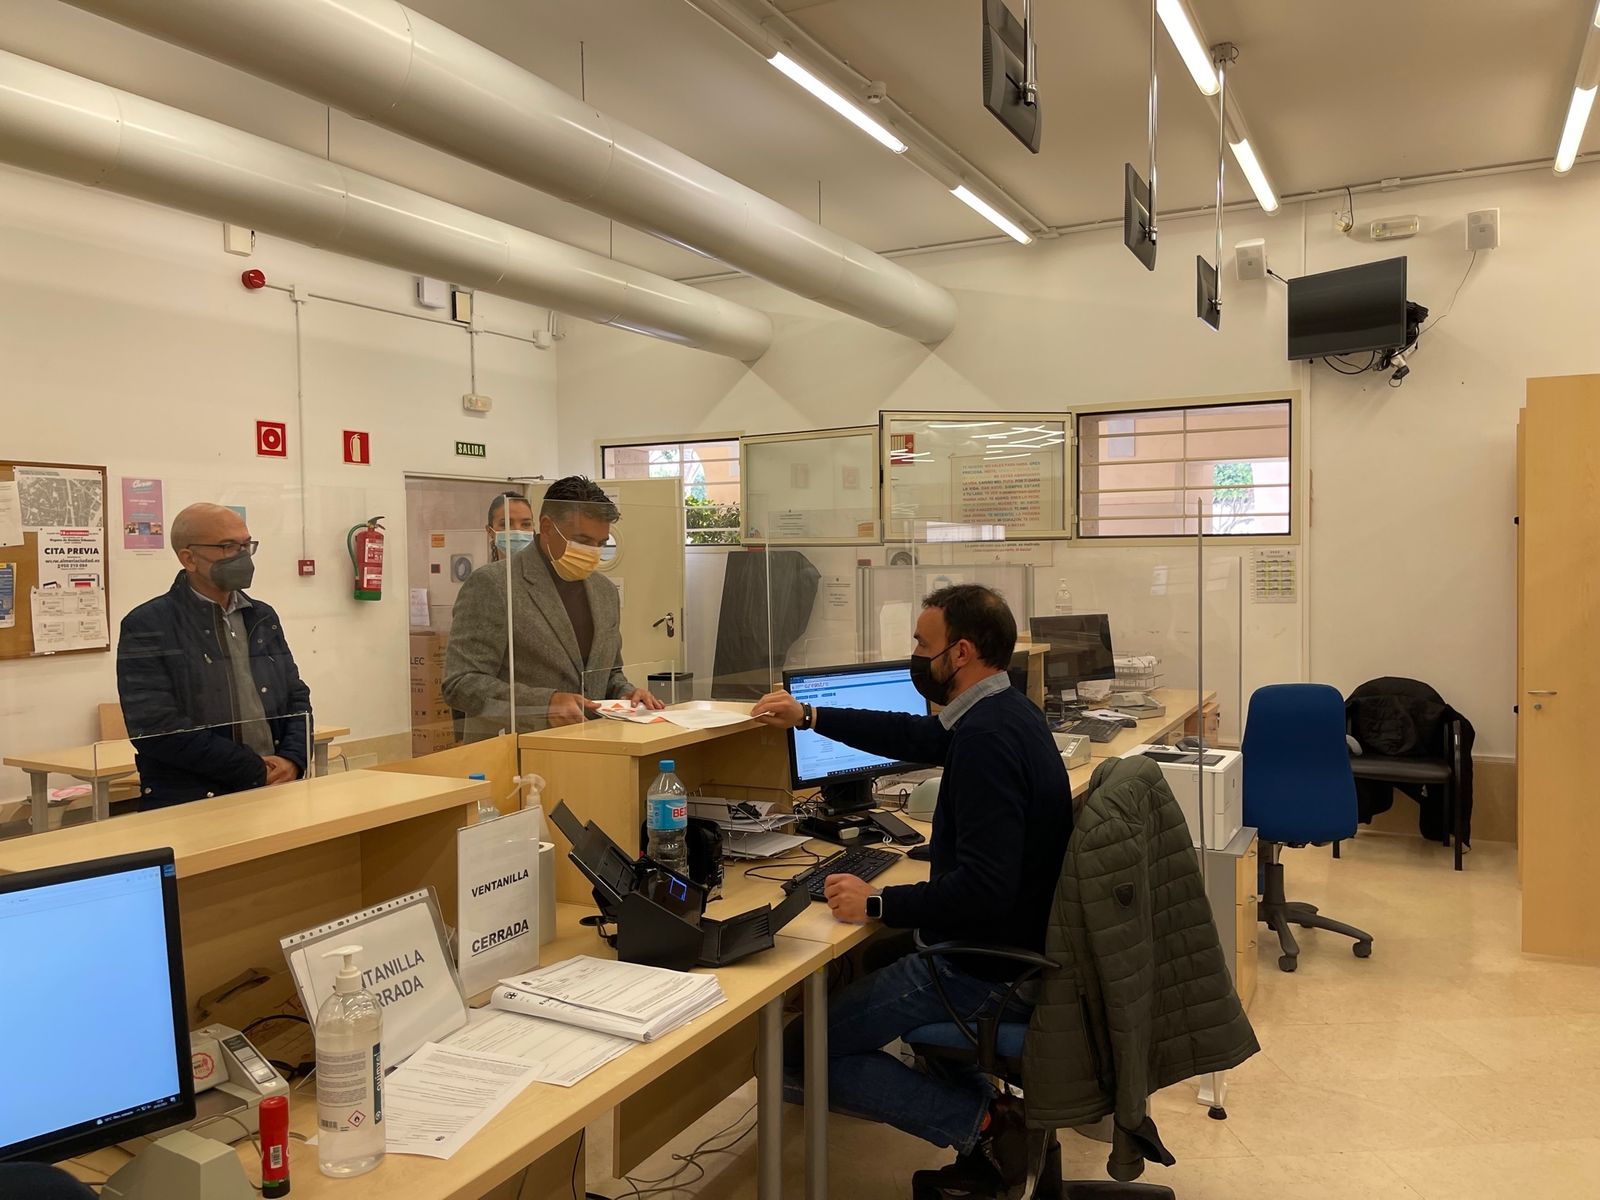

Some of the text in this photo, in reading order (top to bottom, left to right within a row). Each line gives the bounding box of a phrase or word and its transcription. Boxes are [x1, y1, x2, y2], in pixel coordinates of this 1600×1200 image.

[458, 443, 484, 456] SALIDA
[44, 547, 99, 555] CITA PREVIA
[672, 806, 688, 818] BE
[471, 868, 529, 898] VENTANILLA
[471, 918, 529, 954] CERRADA
[372, 975, 424, 1009] RRADA
